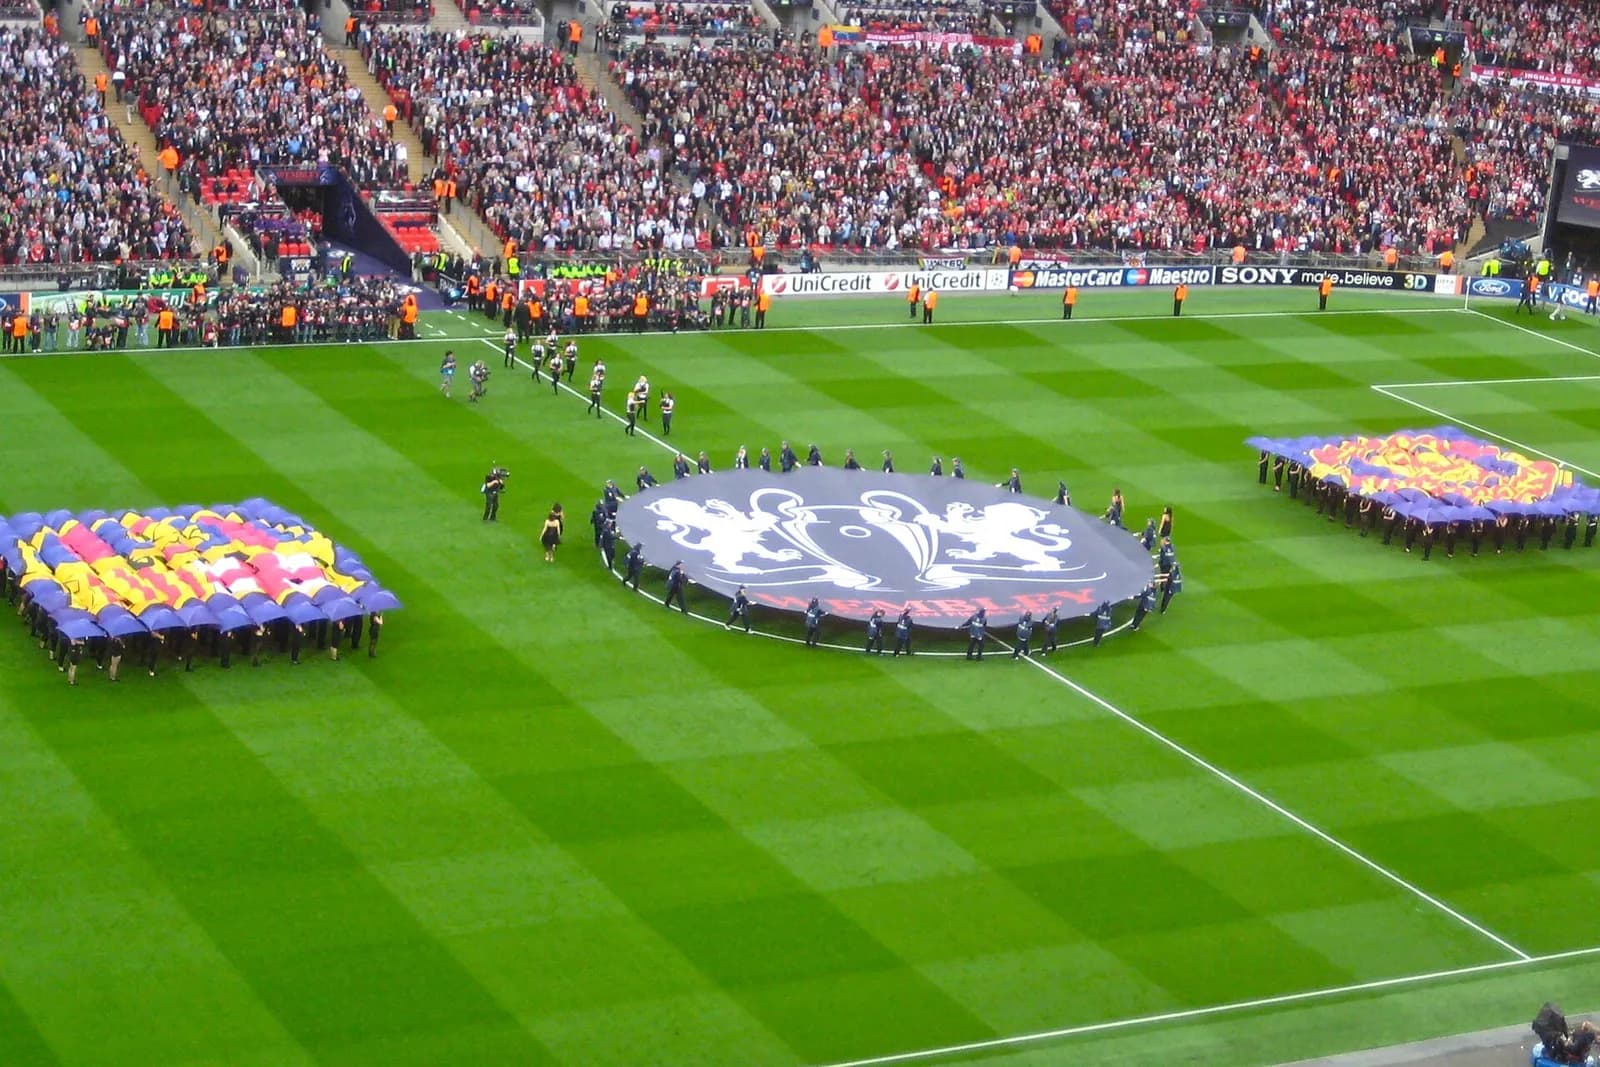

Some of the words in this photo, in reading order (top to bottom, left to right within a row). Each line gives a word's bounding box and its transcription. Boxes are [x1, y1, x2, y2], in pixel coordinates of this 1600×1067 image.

[792, 275, 872, 292] UniCredit
[904, 271, 982, 290] UniCredit
[1035, 269, 1124, 287] MasterCard
[1149, 267, 1210, 285] Maestro
[1221, 267, 1298, 284] SONY
[1403, 274, 1428, 289] 3D
